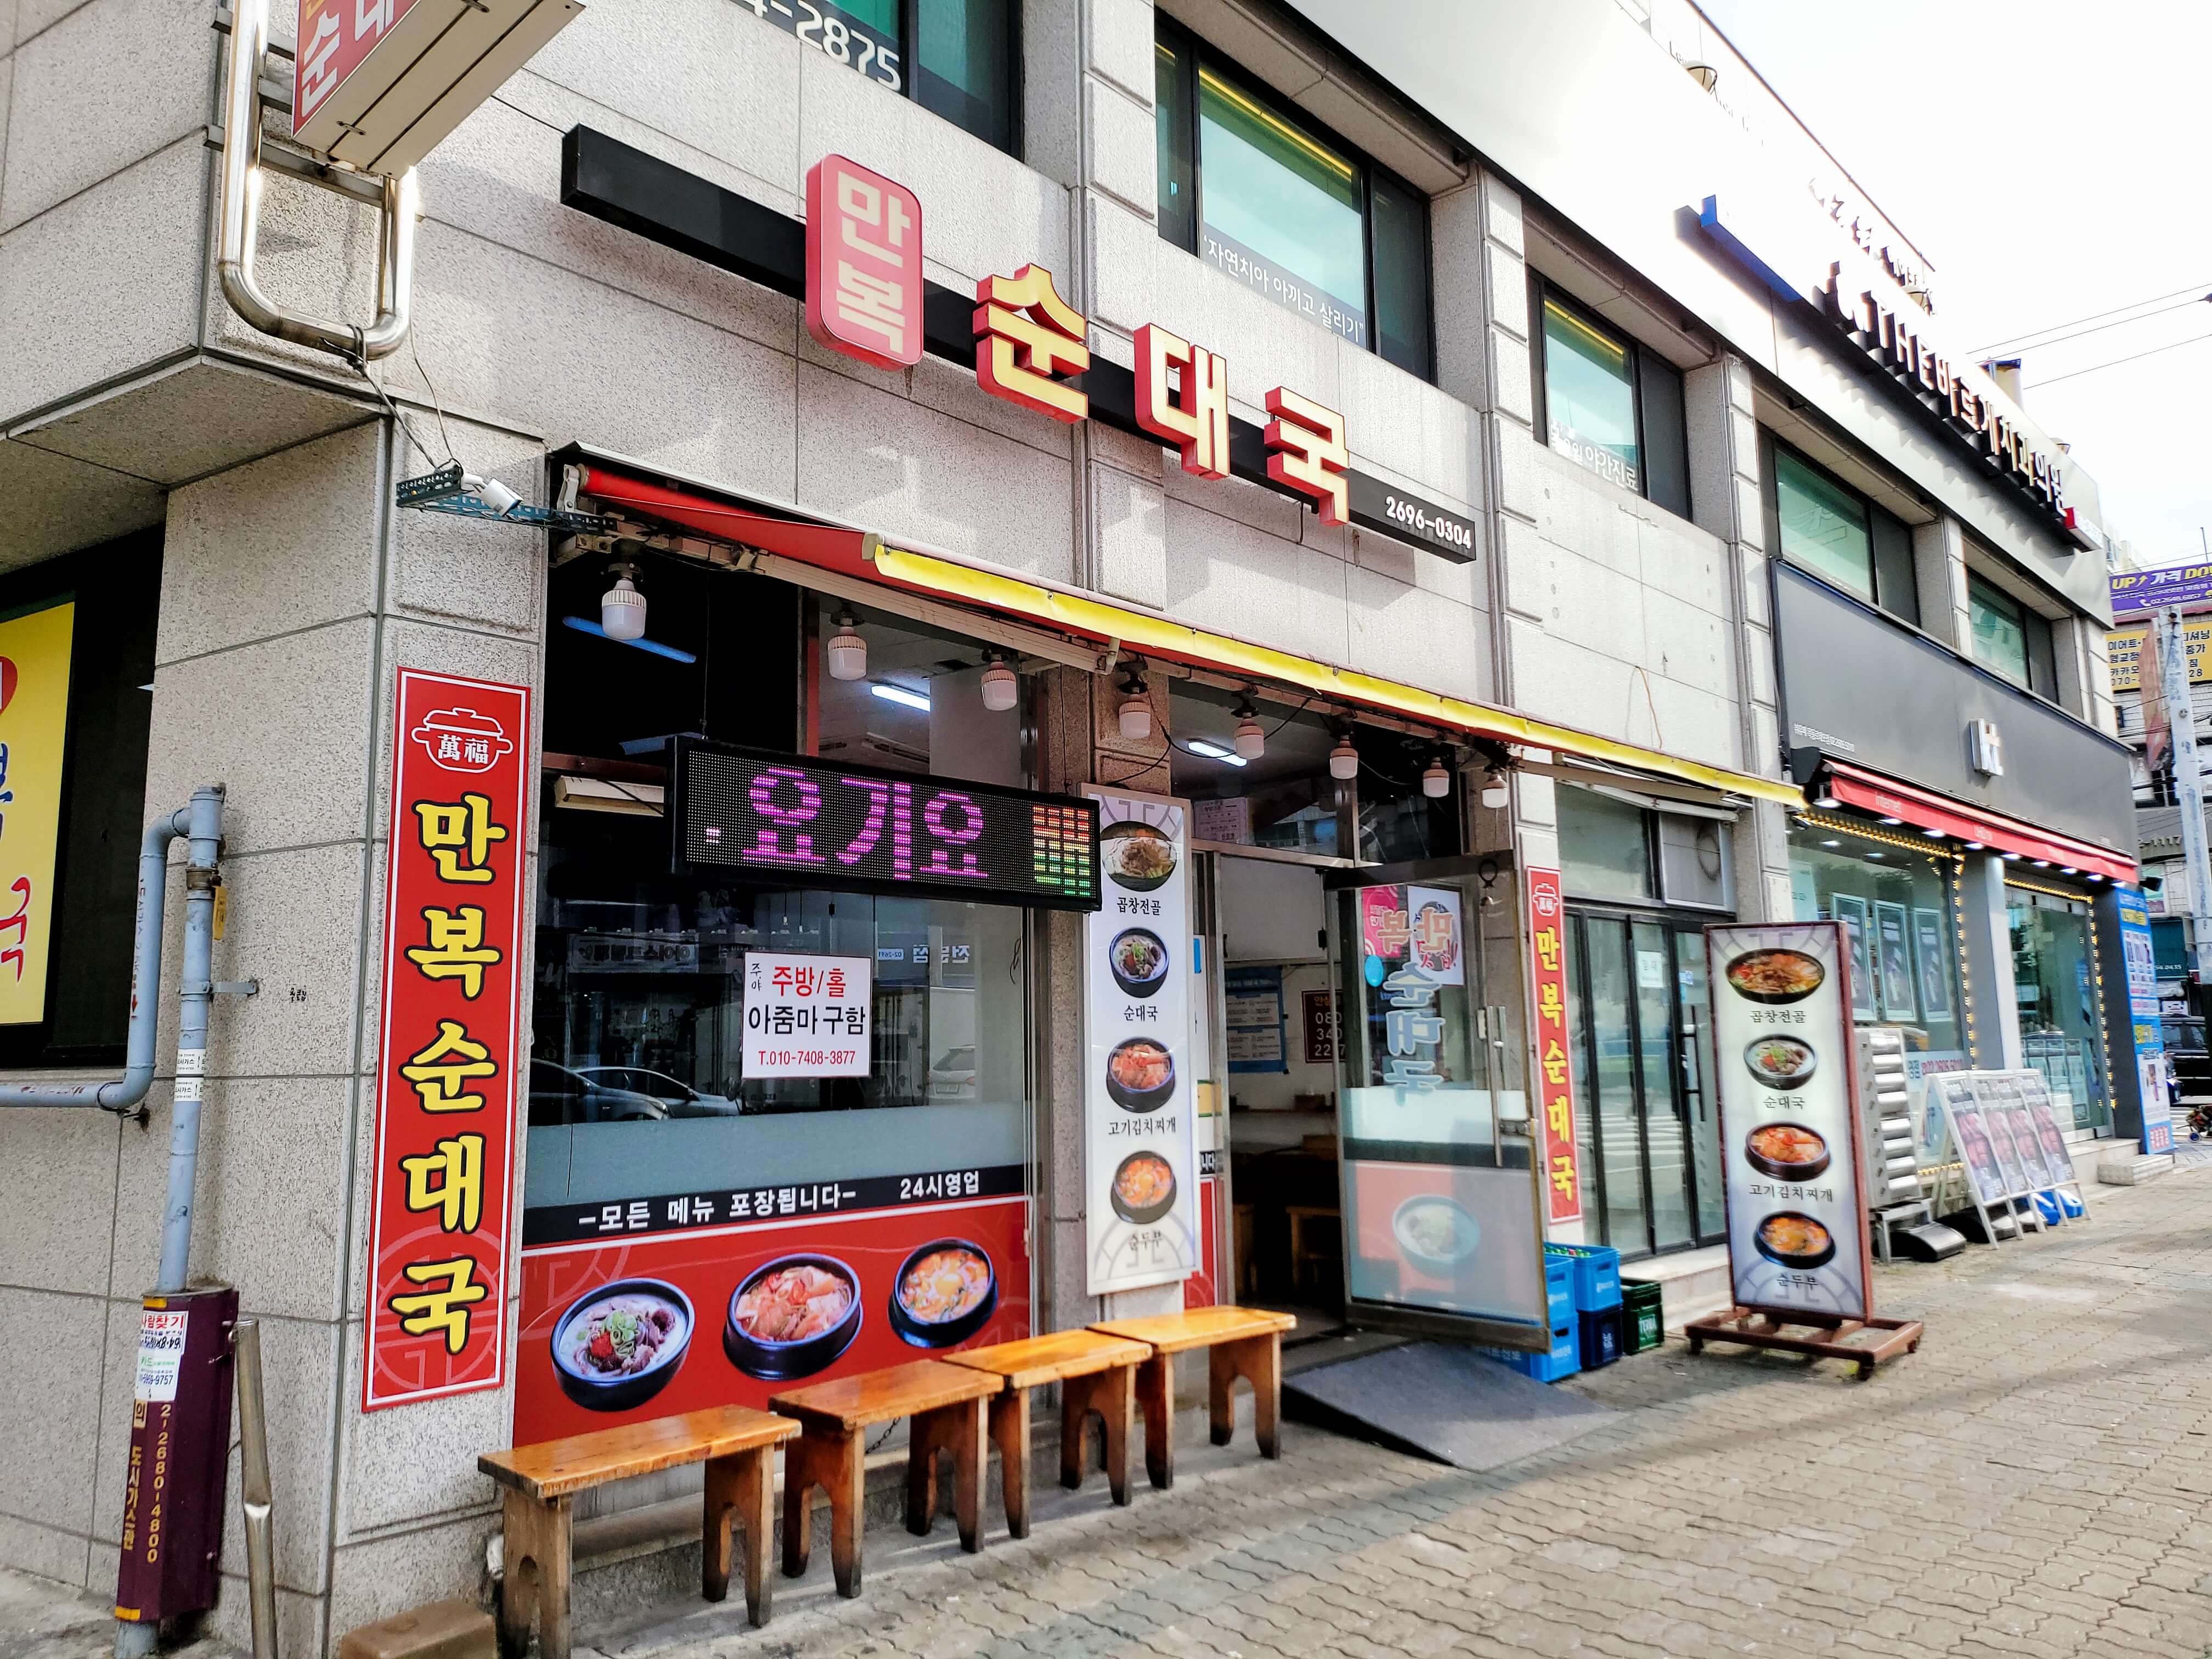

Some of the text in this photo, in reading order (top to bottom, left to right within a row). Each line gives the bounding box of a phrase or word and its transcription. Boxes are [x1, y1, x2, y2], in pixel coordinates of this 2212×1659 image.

[751, 0, 902, 92] -2875
[836, 171, 912, 355] 만복
[1273, 277, 1316, 316] 아끼고
[973, 263, 1350, 526] 순대국
[1584, 445, 1639, 493] 야간진료
[1385, 496, 1472, 549] 2696-0304
[2112, 577, 2136, 590] UP
[437, 733, 490, 765] 萬福
[741, 766, 989, 881] 요기요
[1116, 896, 1163, 917] 곱창전골
[772, 966, 847, 998] 주방/홀
[748, 1004, 866, 1035] 아줌마 구함
[1123, 1005, 1159, 1023] 순대국
[1750, 1009, 1807, 1024] 곱창전골
[758, 1050, 856, 1065] T.010-7408-3877
[1314, 1043, 1347, 1057] 227
[1534, 926, 1576, 1202] 만복순대국
[388, 791, 510, 1355] 만복순대국
[1762, 1096, 1807, 1110] 순대국
[1108, 1116, 1177, 1137] 고기김치찌개
[668, 1198, 715, 1227] 메뉴
[899, 1170, 981, 1201] 24시영업
[1748, 1183, 1835, 1204] 고기김치찌개
[1775, 1274, 1820, 1291] 순두부
